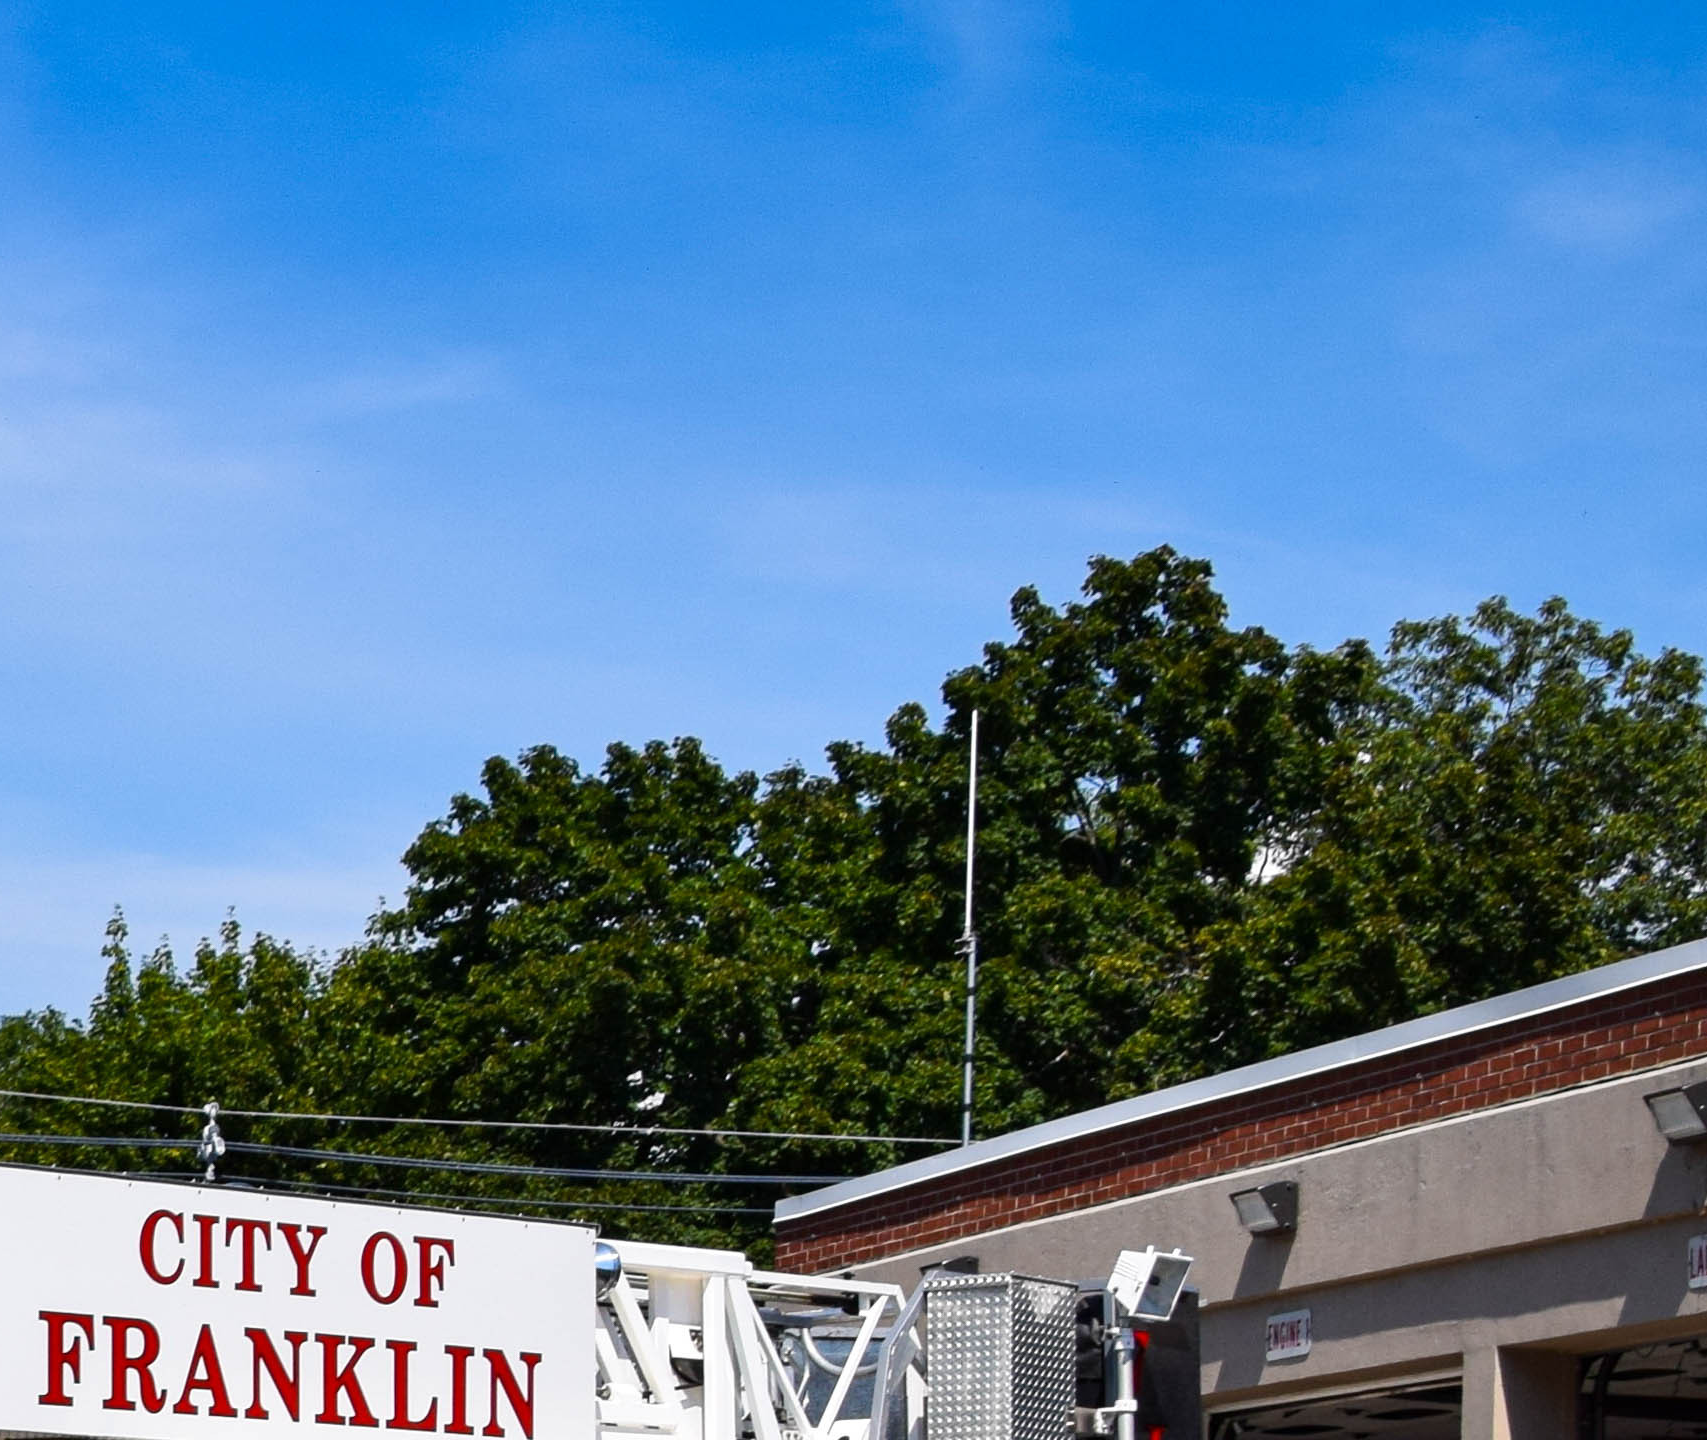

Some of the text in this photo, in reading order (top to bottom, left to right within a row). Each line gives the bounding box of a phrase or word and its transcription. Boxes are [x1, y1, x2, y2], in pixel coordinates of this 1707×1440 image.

[138, 1209, 456, 1309] CITY OF
[38, 1309, 543, 1440] FRANKLIN
[1267, 1319, 1301, 1351] ENGINE
